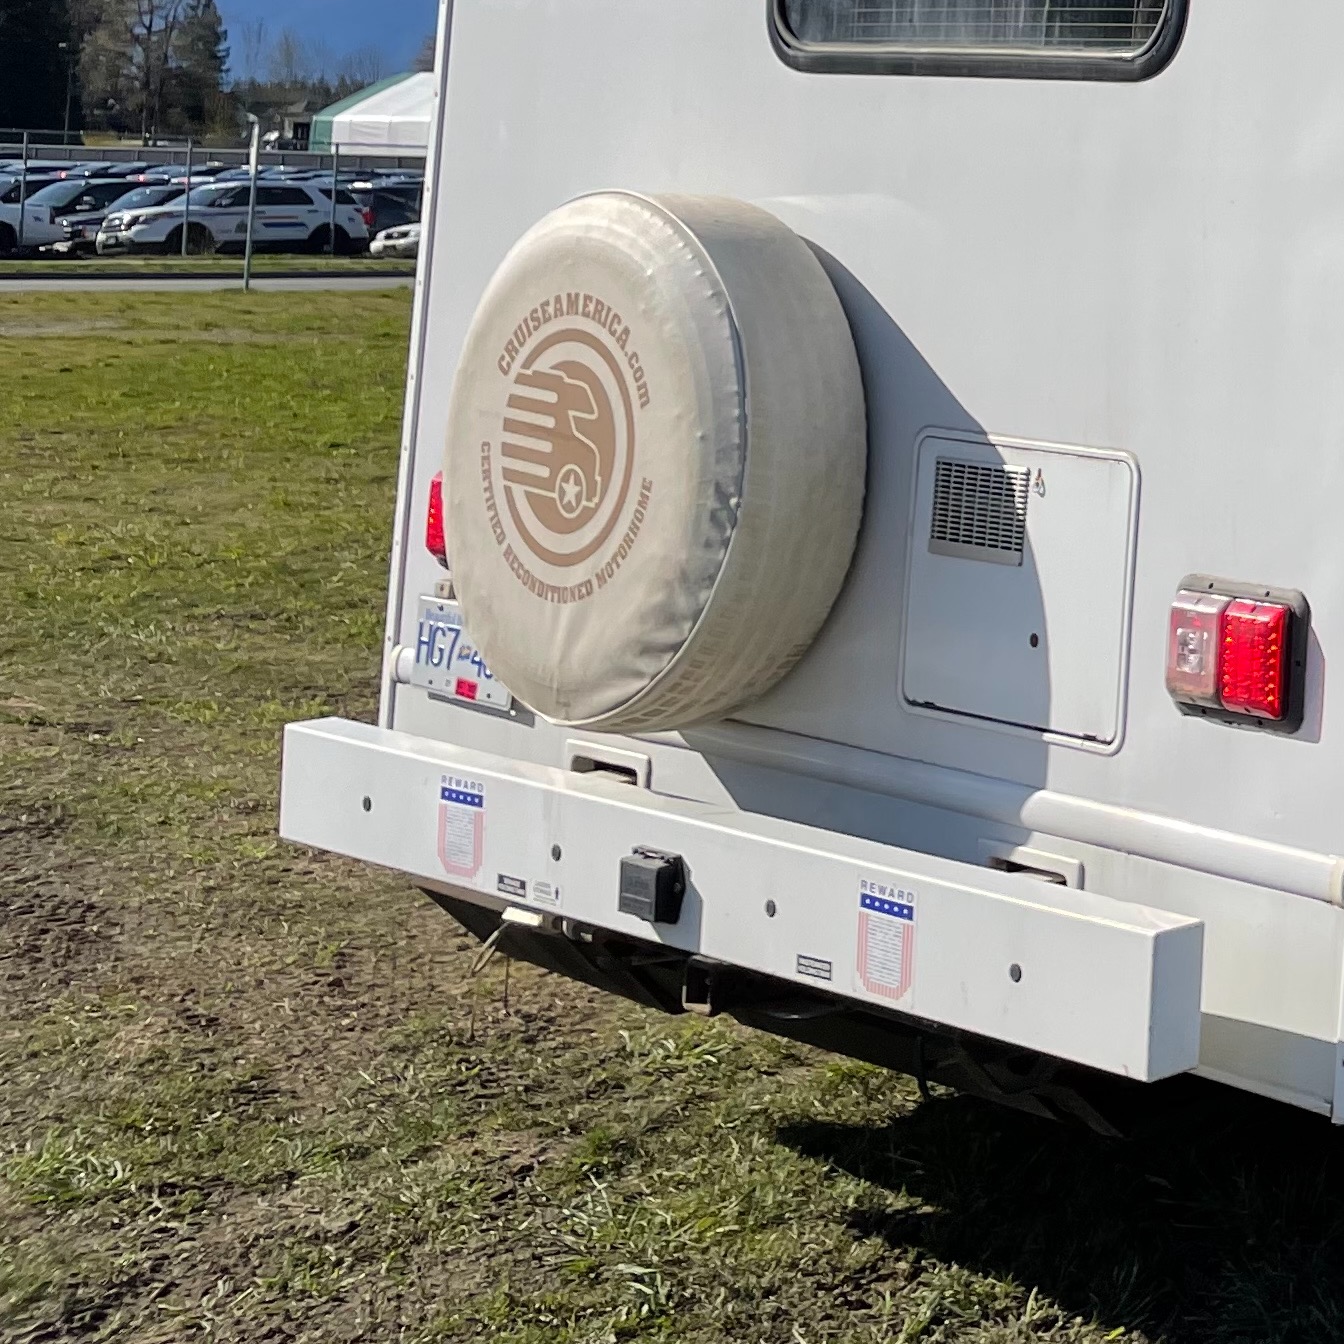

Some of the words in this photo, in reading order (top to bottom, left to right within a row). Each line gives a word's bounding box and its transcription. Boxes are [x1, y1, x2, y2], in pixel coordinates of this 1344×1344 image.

[497, 292, 651, 409] CRUISEAMERICA.com
[481, 441, 506, 546] CERTIFIED
[503, 543, 594, 604] RECONDITIONED
[595, 477, 653, 589] MOTORHOME
[416, 621, 461, 670] HG7
[441, 774, 484, 793] REWARD
[861, 879, 914, 904] REWARD
